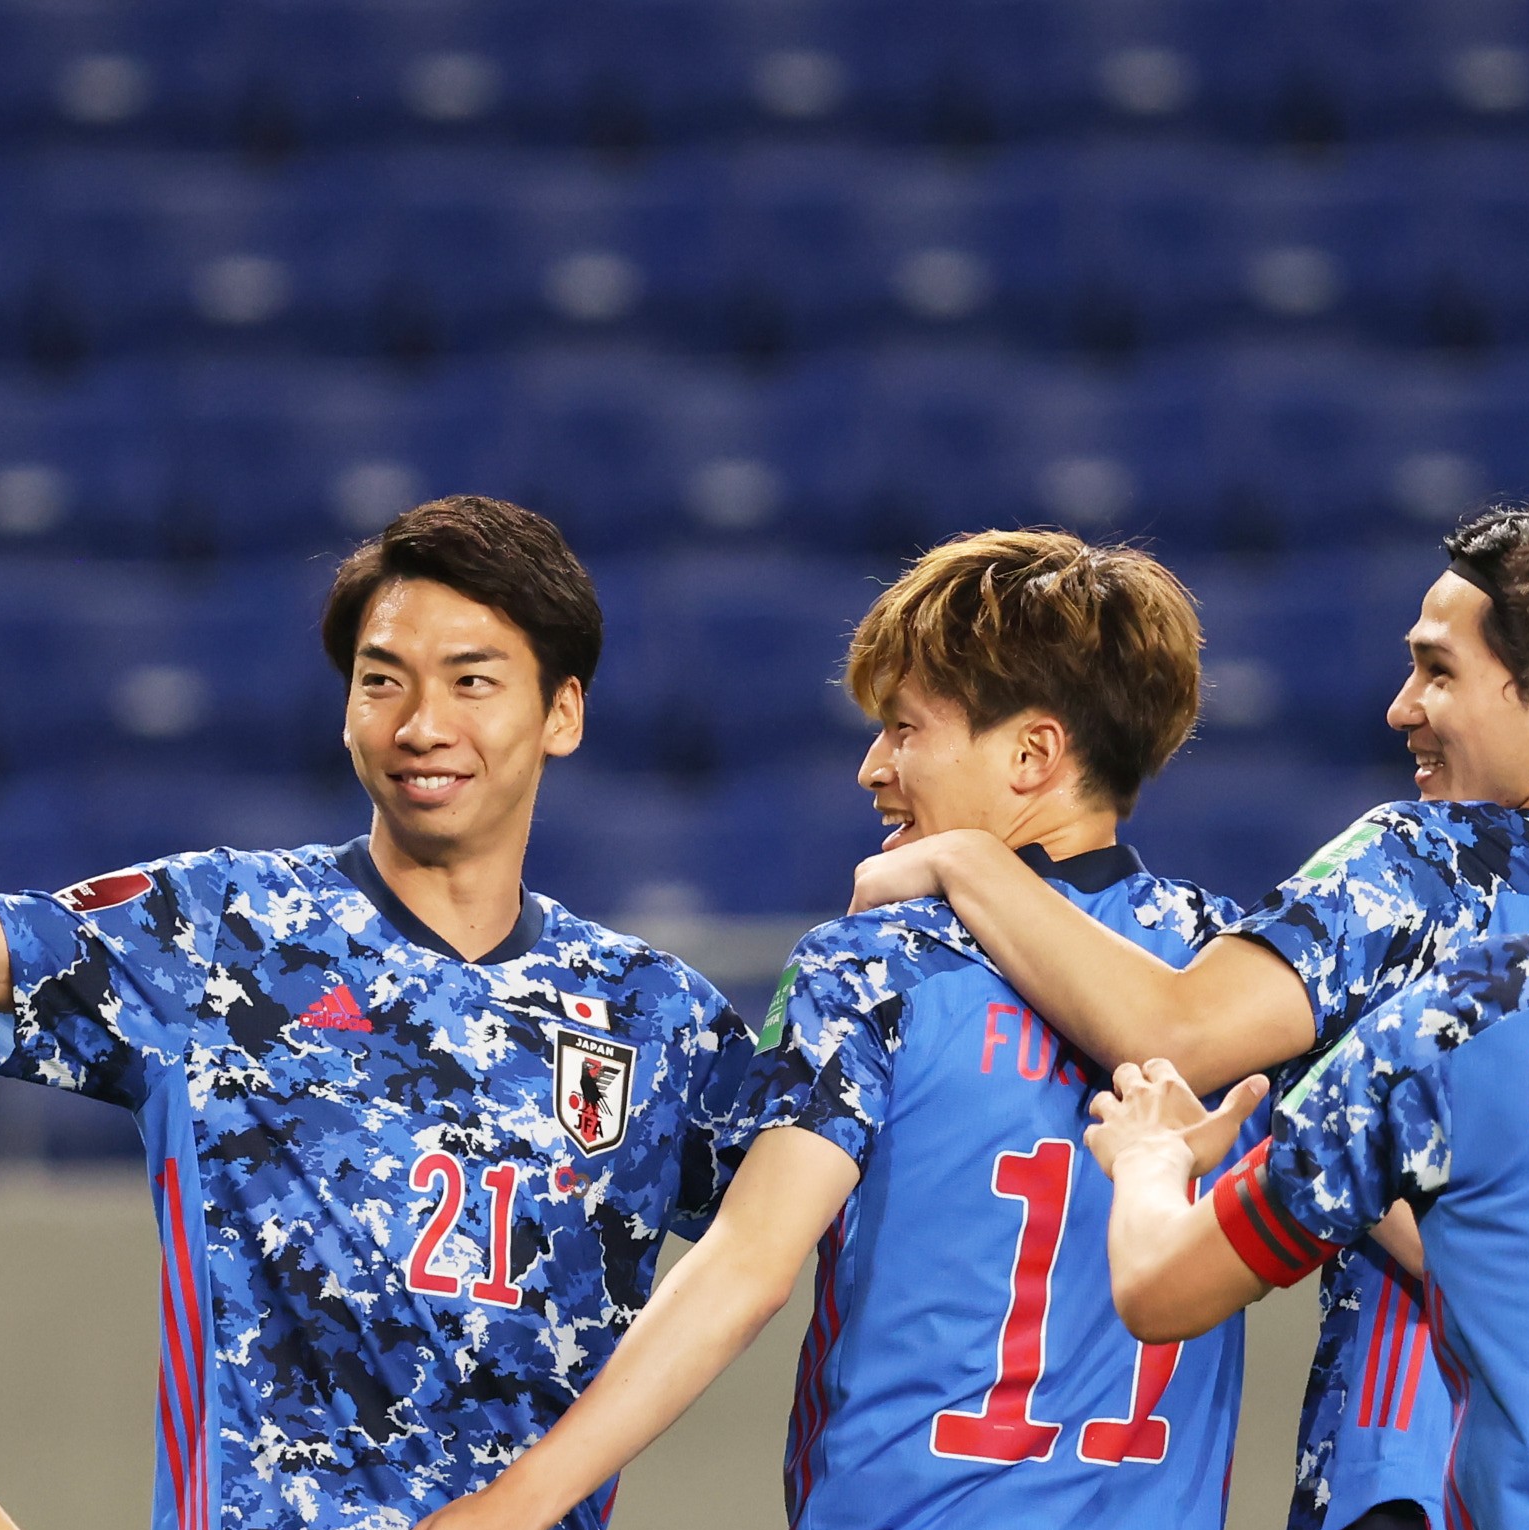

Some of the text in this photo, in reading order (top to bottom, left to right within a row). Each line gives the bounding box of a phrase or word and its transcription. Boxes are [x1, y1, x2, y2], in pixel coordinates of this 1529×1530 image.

[299, 1011, 374, 1033] adidas
[575, 1036, 615, 1058] JAPAN
[573, 1113, 605, 1139] JFA
[405, 1148, 524, 1310] 21
